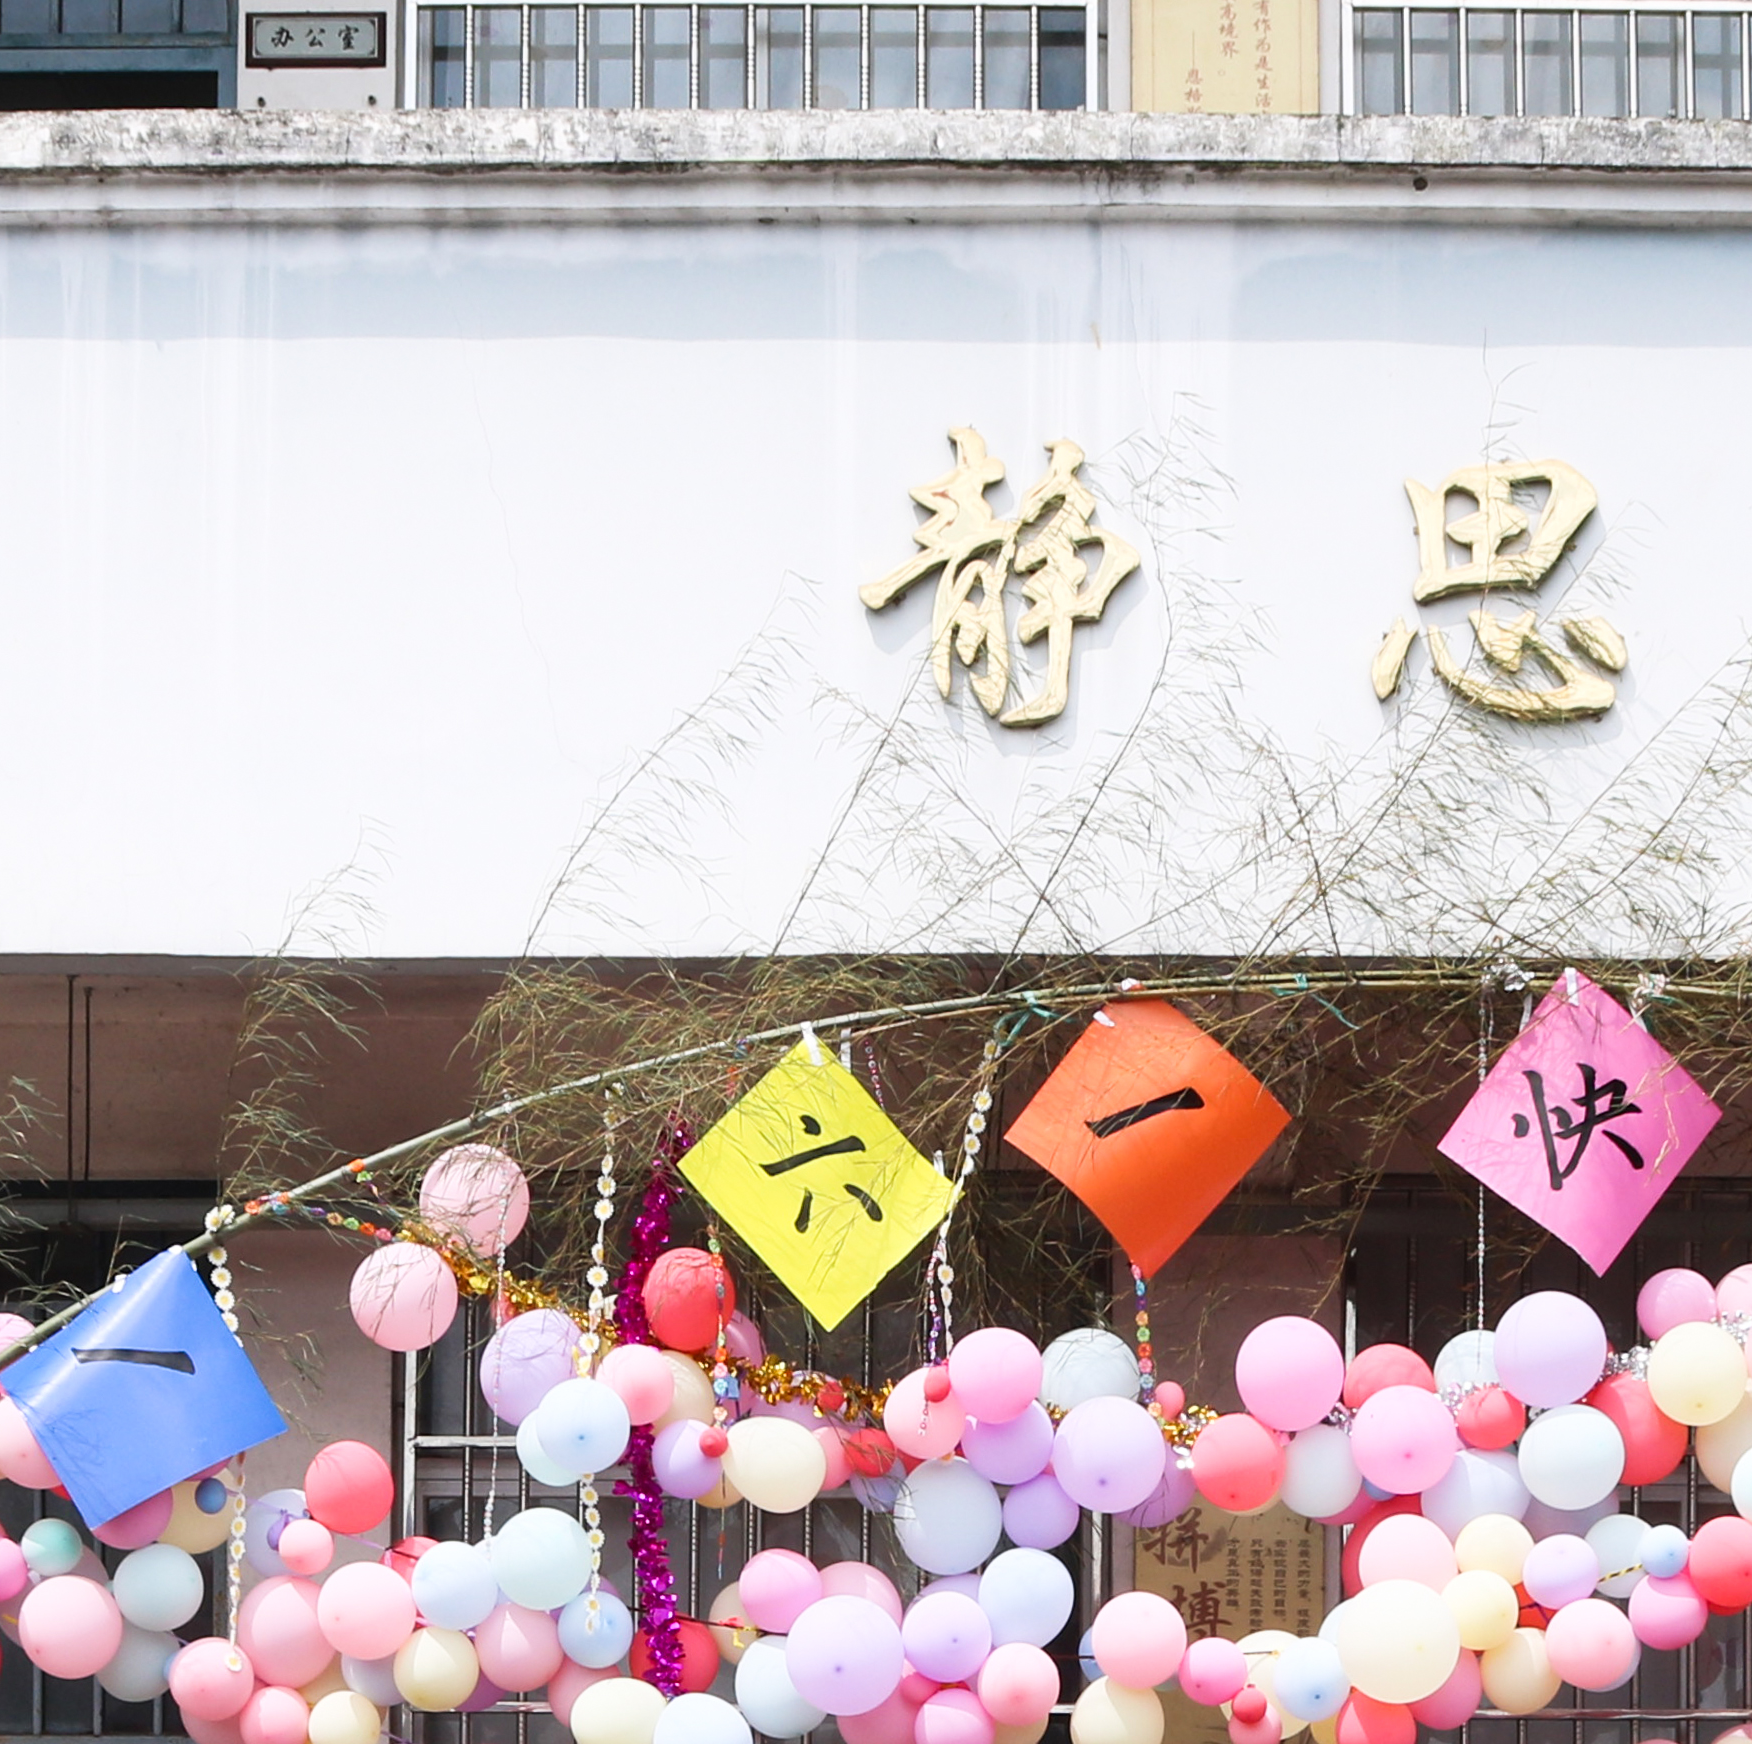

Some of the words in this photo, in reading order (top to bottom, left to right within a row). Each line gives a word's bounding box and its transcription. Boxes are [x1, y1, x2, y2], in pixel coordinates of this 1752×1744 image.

[271, 25, 359, 50] 办公室
[1086, 1087, 1206, 1139] 一
[1513, 1062, 1645, 1191] 快
[760, 1113, 883, 1233] 六
[73, 1347, 197, 1376] 一
